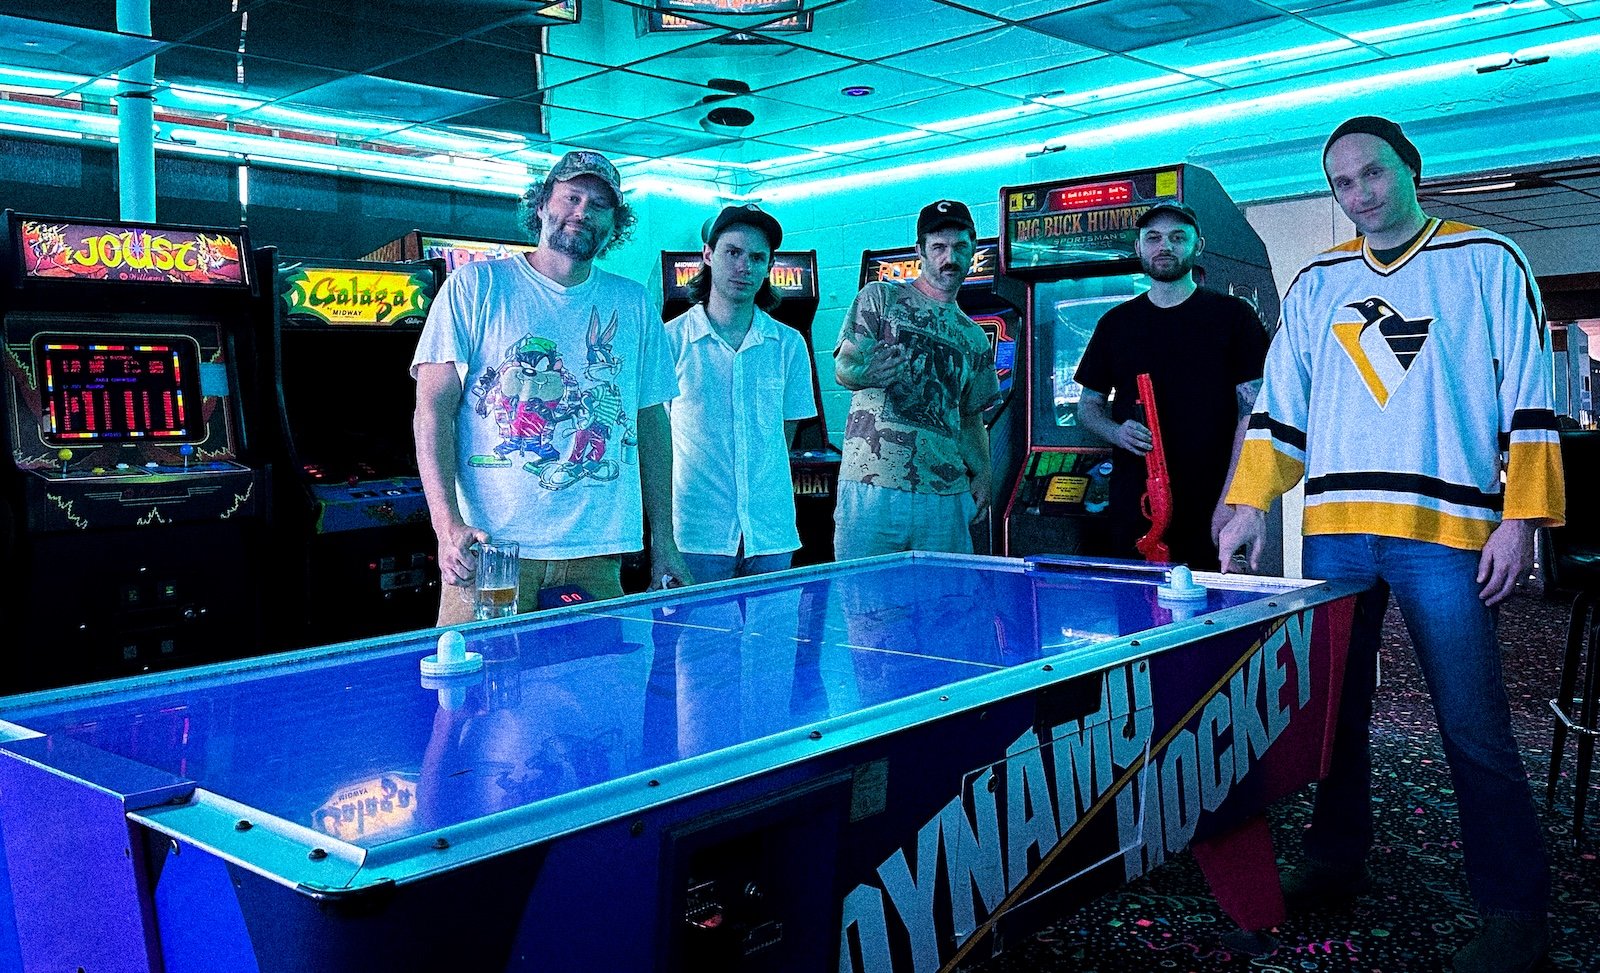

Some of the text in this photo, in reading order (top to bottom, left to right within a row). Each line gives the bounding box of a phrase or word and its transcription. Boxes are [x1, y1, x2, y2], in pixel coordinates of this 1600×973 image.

[937, 201, 951, 213] C
[1017, 219, 1040, 242] BIG
[1044, 213, 1083, 238] BUCK
[1053, 233, 1126, 245] SPORTSMAN'S
[73, 231, 197, 272] JOUST
[770, 267, 803, 287] BAT
[308, 276, 408, 322] Galaga
[794, 473, 832, 494] BAT
[1115, 607, 1315, 884] HOCKEY
